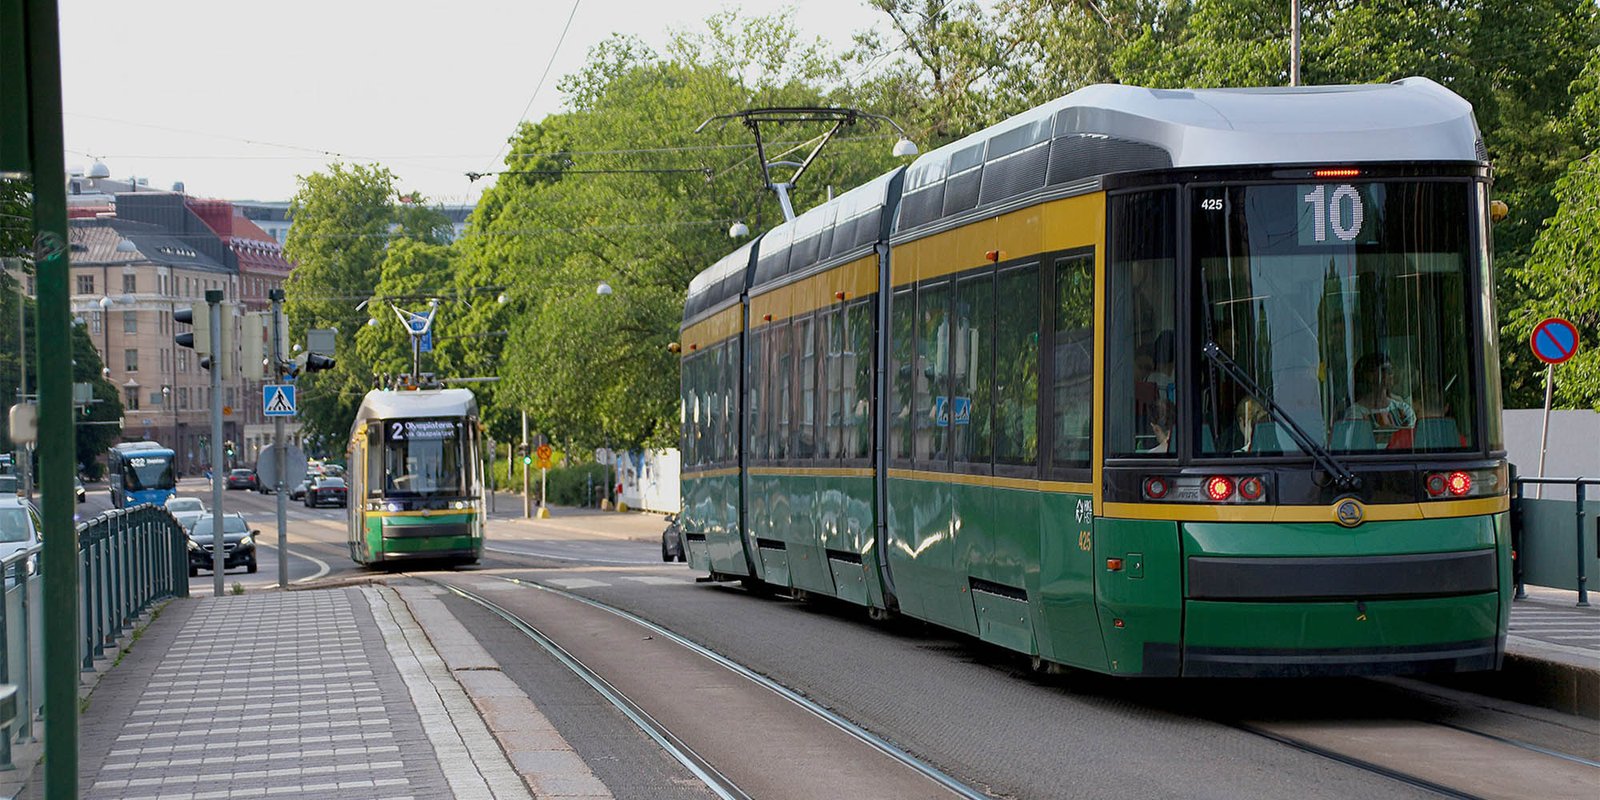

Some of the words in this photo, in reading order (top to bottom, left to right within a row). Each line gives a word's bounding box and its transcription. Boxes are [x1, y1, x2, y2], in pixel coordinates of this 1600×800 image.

[1201, 199, 1223, 210] 425
[1304, 184, 1364, 242] 10
[392, 422, 404, 440] 2
[130, 458, 146, 468] 322
[1079, 530, 1091, 551] 425
